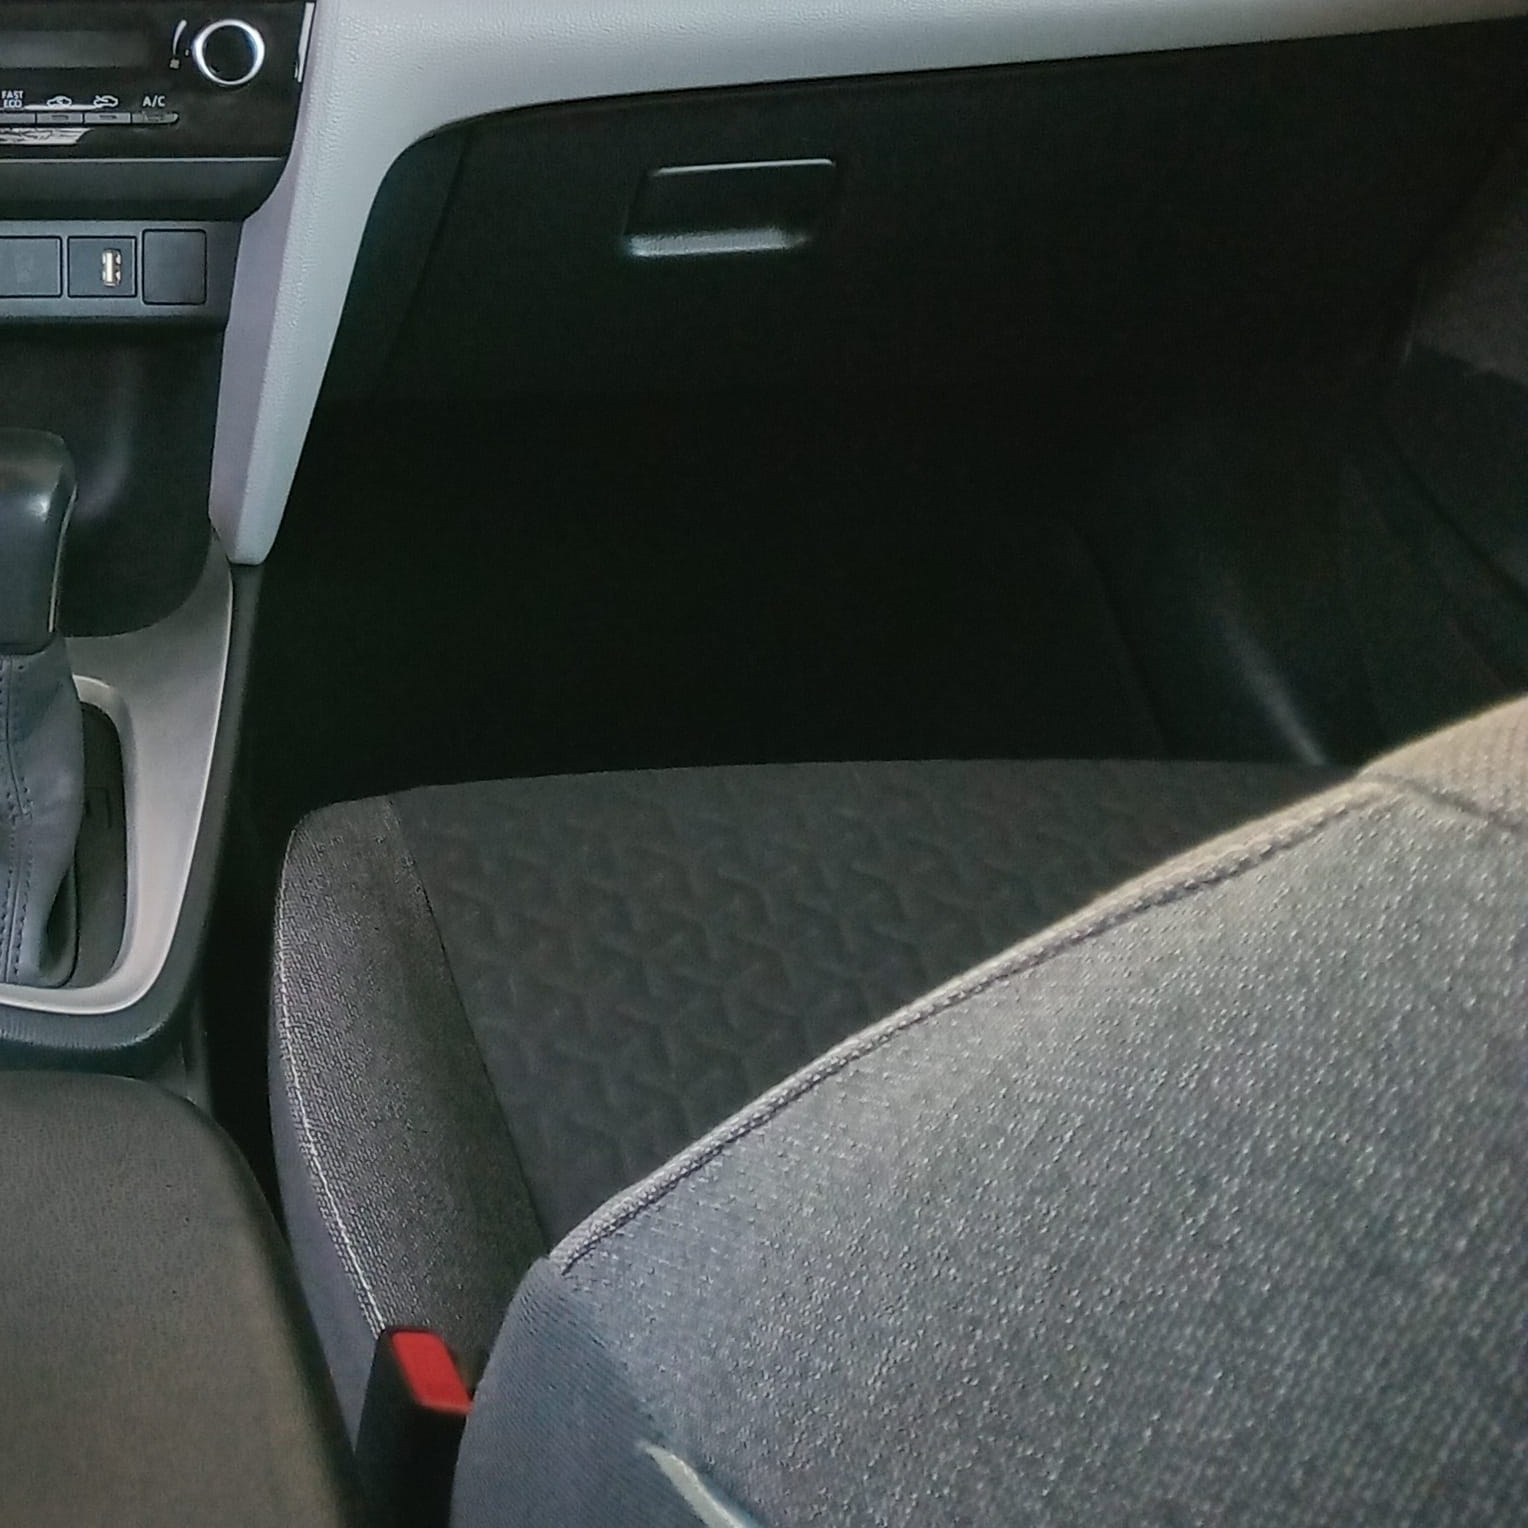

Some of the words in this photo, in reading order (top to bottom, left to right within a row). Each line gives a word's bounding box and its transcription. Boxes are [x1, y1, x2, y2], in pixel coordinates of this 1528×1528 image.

[1, 90, 24, 99] FAST
[3, 99, 22, 108] ECO
[142, 95, 166, 107] A/C
